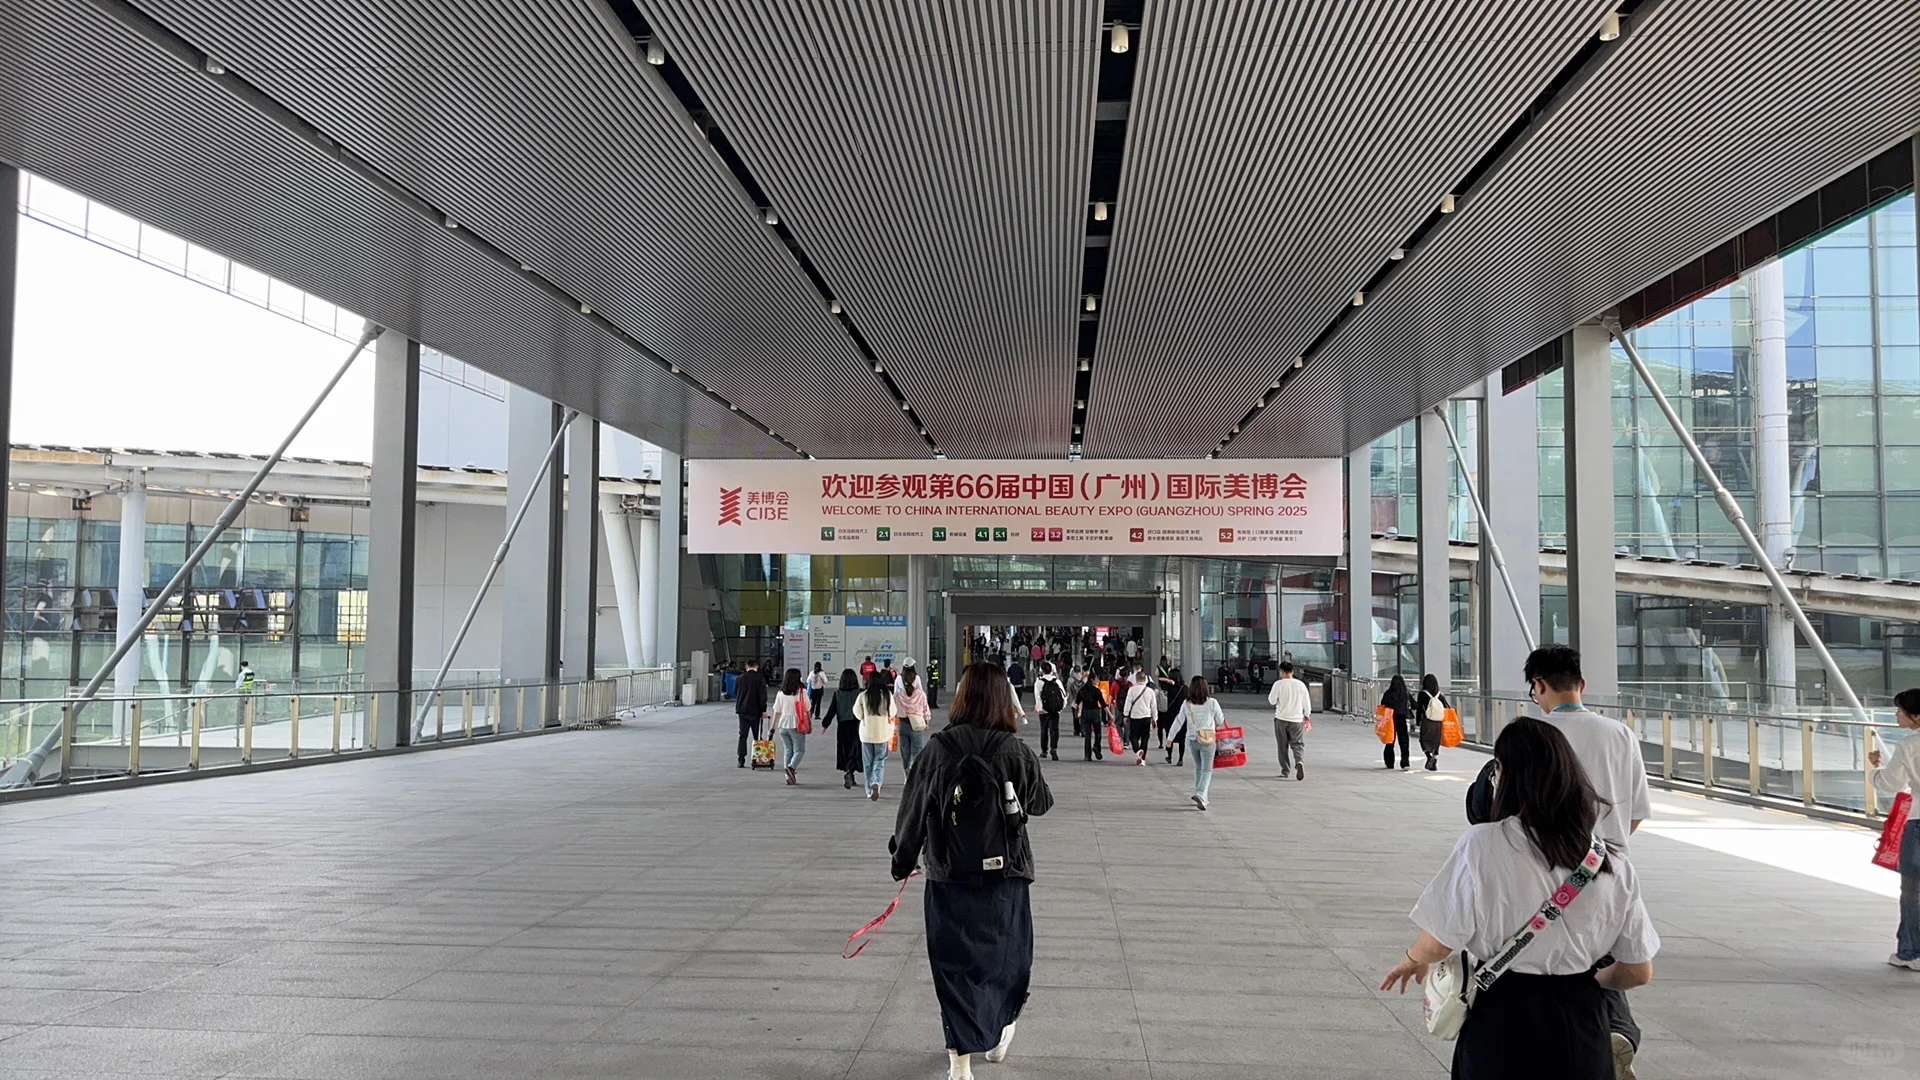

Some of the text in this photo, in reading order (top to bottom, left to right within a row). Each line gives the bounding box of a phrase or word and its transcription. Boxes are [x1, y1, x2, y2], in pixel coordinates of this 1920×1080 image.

[820, 472, 1308, 501] 欢迎参观第66届中国（广州）国际美博会
[746, 491, 790, 506] 美博会
[746, 507, 790, 521] CIBE
[821, 505, 1308, 517] WELCOME TO CHINA INTERNATIONAL BEAUTY EXPO (GUANGZHOU) SPRING 2025
[1050, 531, 1062, 539] 3.2
